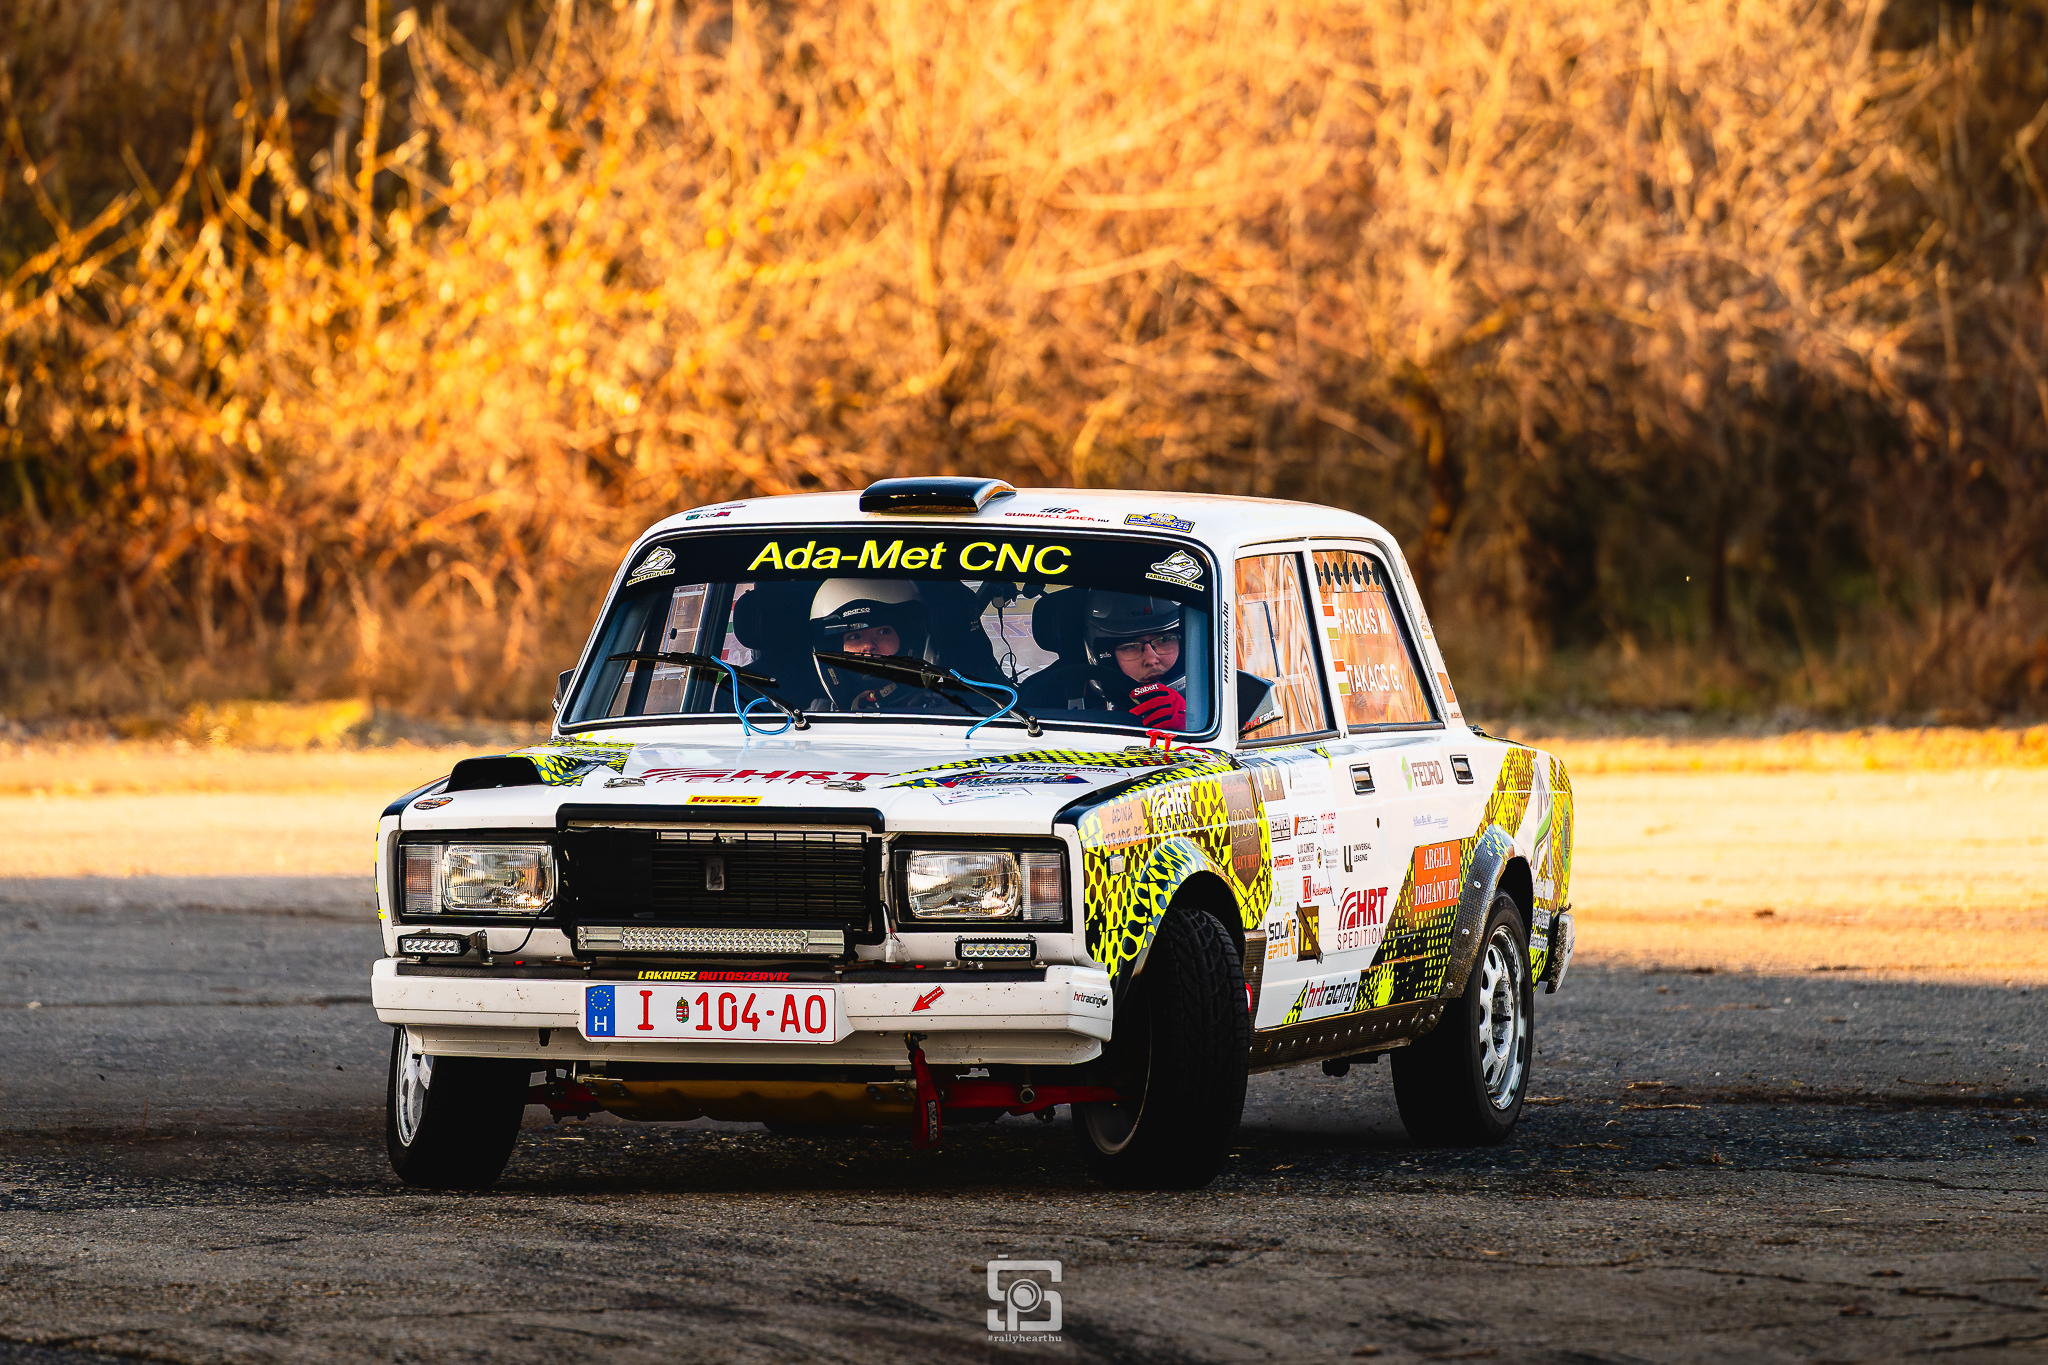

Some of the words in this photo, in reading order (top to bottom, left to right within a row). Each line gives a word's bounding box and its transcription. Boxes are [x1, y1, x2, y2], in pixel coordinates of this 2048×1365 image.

[747, 540, 947, 571] Ada-Met
[959, 541, 1072, 575] CNC
[843, 607, 871, 617] sparco
[1336, 608, 1378, 635] FARKAS
[1378, 608, 1391, 635] M.
[1346, 657, 1389, 693] TAKÁCS
[1390, 663, 1403, 692] G.
[730, 769, 890, 781] HRT
[691, 796, 759, 805] PIRELLI
[1165, 785, 1192, 816] HRT
[1424, 846, 1452, 870] ARGILA
[1415, 875, 1447, 906] DOHÁNY
[1357, 887, 1388, 928] HRT
[1268, 918, 1297, 941] SOLAR
[1337, 926, 1384, 951] SPEDITION
[638, 971, 697, 980] LAKROSZ
[1073, 991, 1101, 1009] hrtracing
[1304, 977, 1358, 1012] hrtracing
[594, 1015, 607, 1032] H
